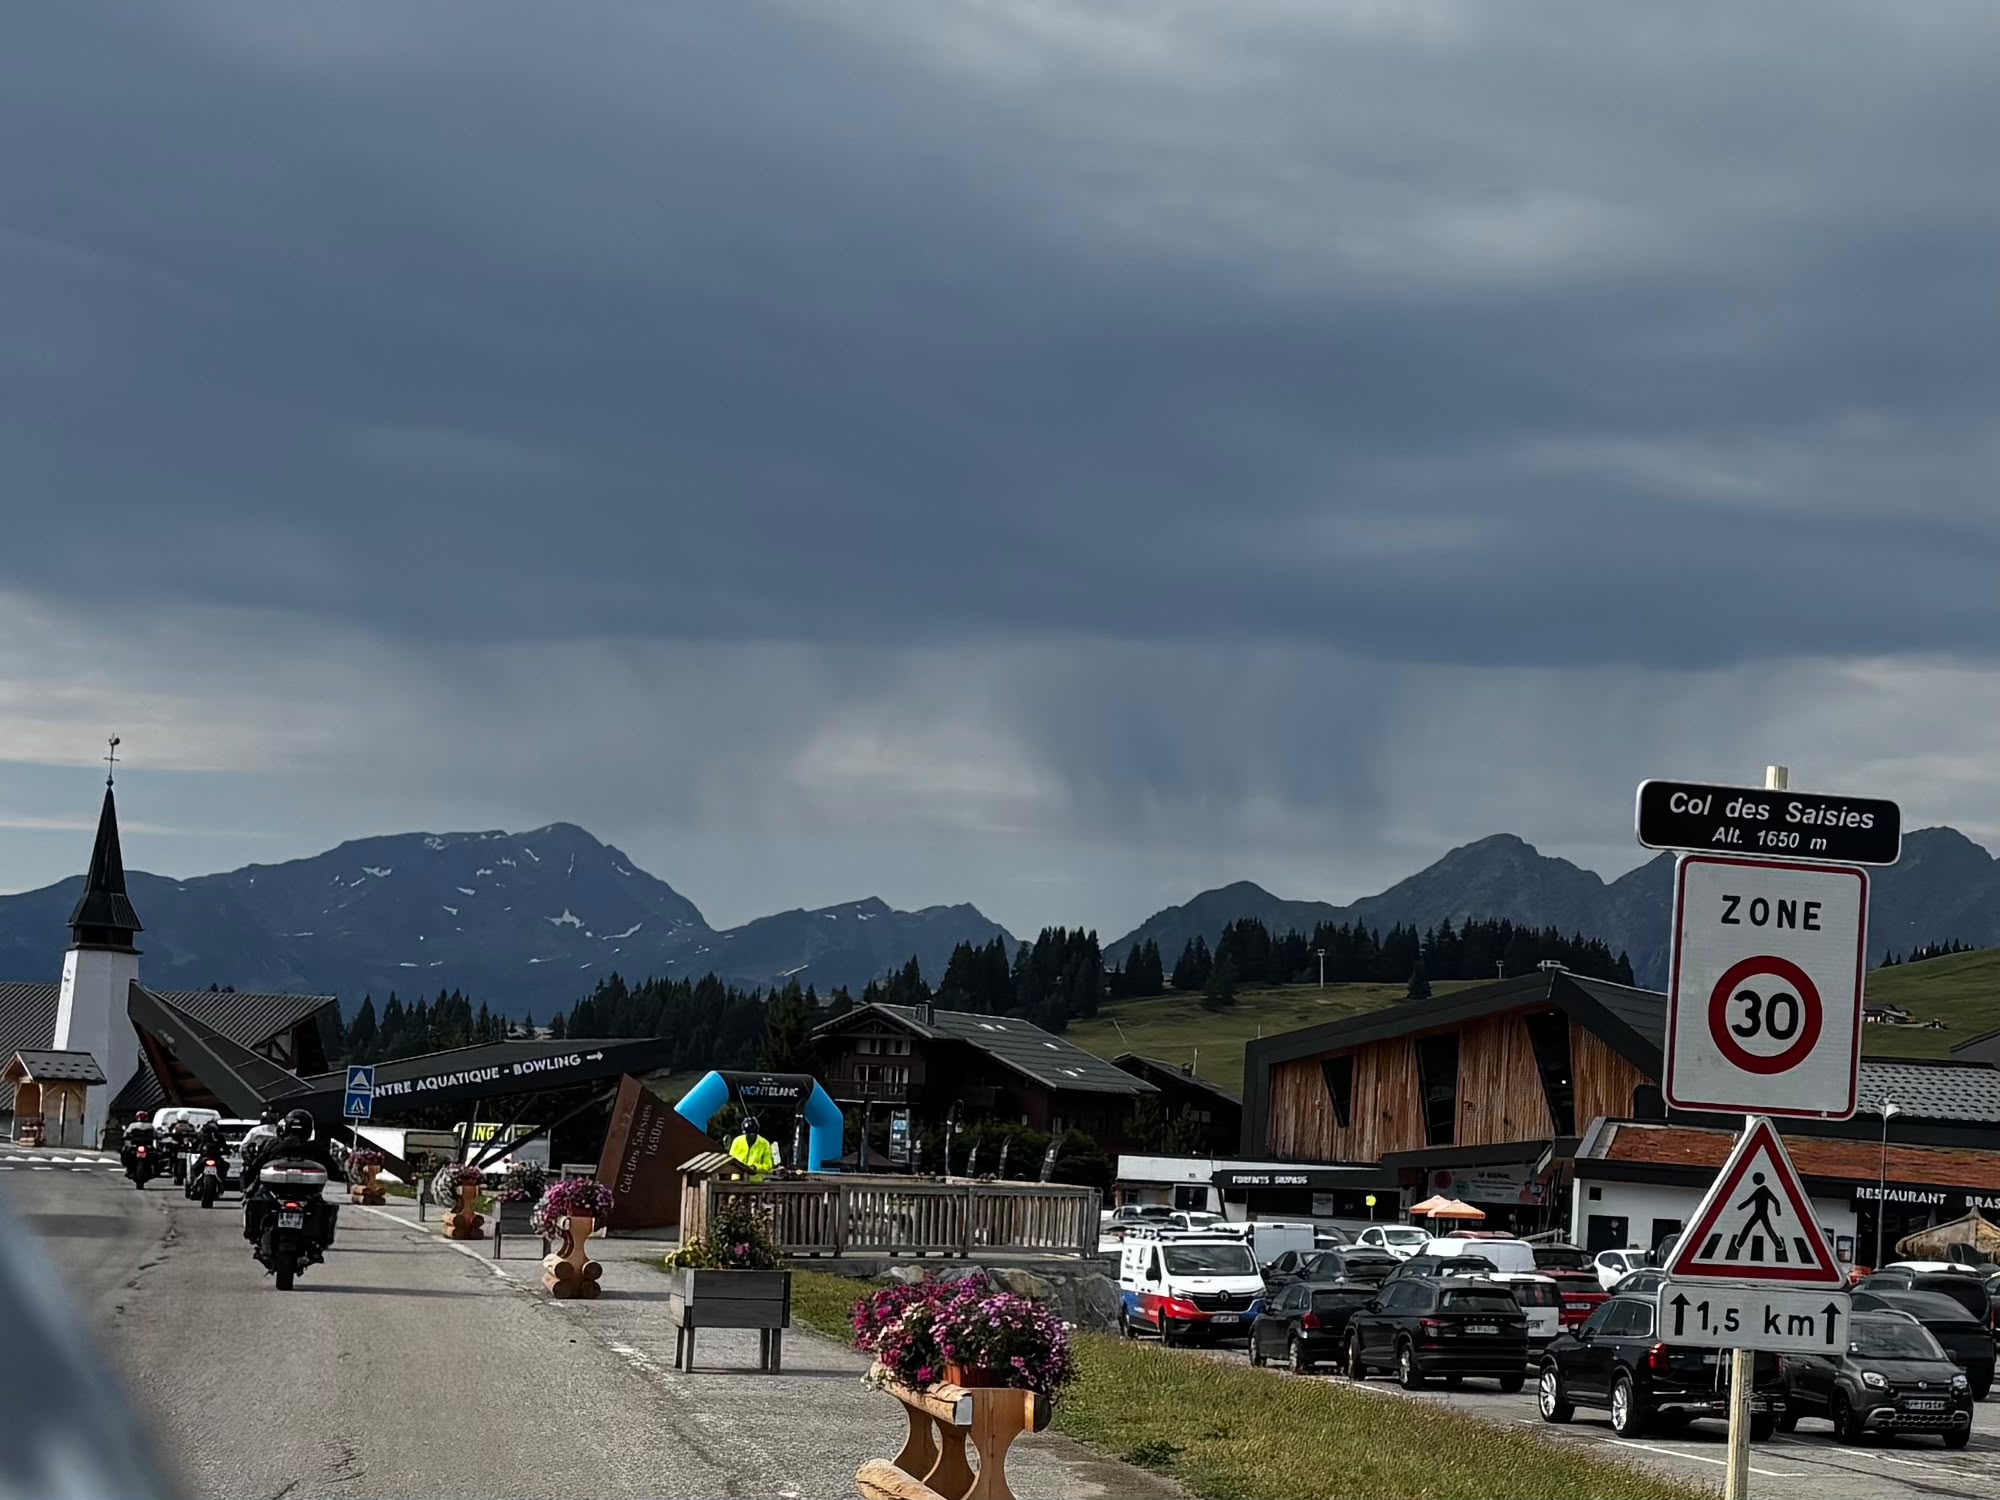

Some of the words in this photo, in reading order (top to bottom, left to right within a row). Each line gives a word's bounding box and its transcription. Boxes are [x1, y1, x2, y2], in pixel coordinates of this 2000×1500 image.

[1669, 792, 1712, 816] Col
[1725, 797, 1770, 820] des
[1785, 802, 1875, 829] Saisies
[1712, 826, 1743, 844] Alt.
[1757, 830, 1800, 849] 1650
[1809, 837, 1827, 850] m
[1721, 895, 1822, 931] ZONE
[1731, 989, 1799, 1041] 30
[372, 1081, 412, 1098] NTRE
[416, 1066, 500, 1091] AQUATIQUE
[513, 1053, 582, 1076] BOWLING
[1856, 1186, 1947, 1205] RESTAURANT
[1697, 1301, 1740, 1336] 1,5
[1764, 1304, 1815, 1337] km
